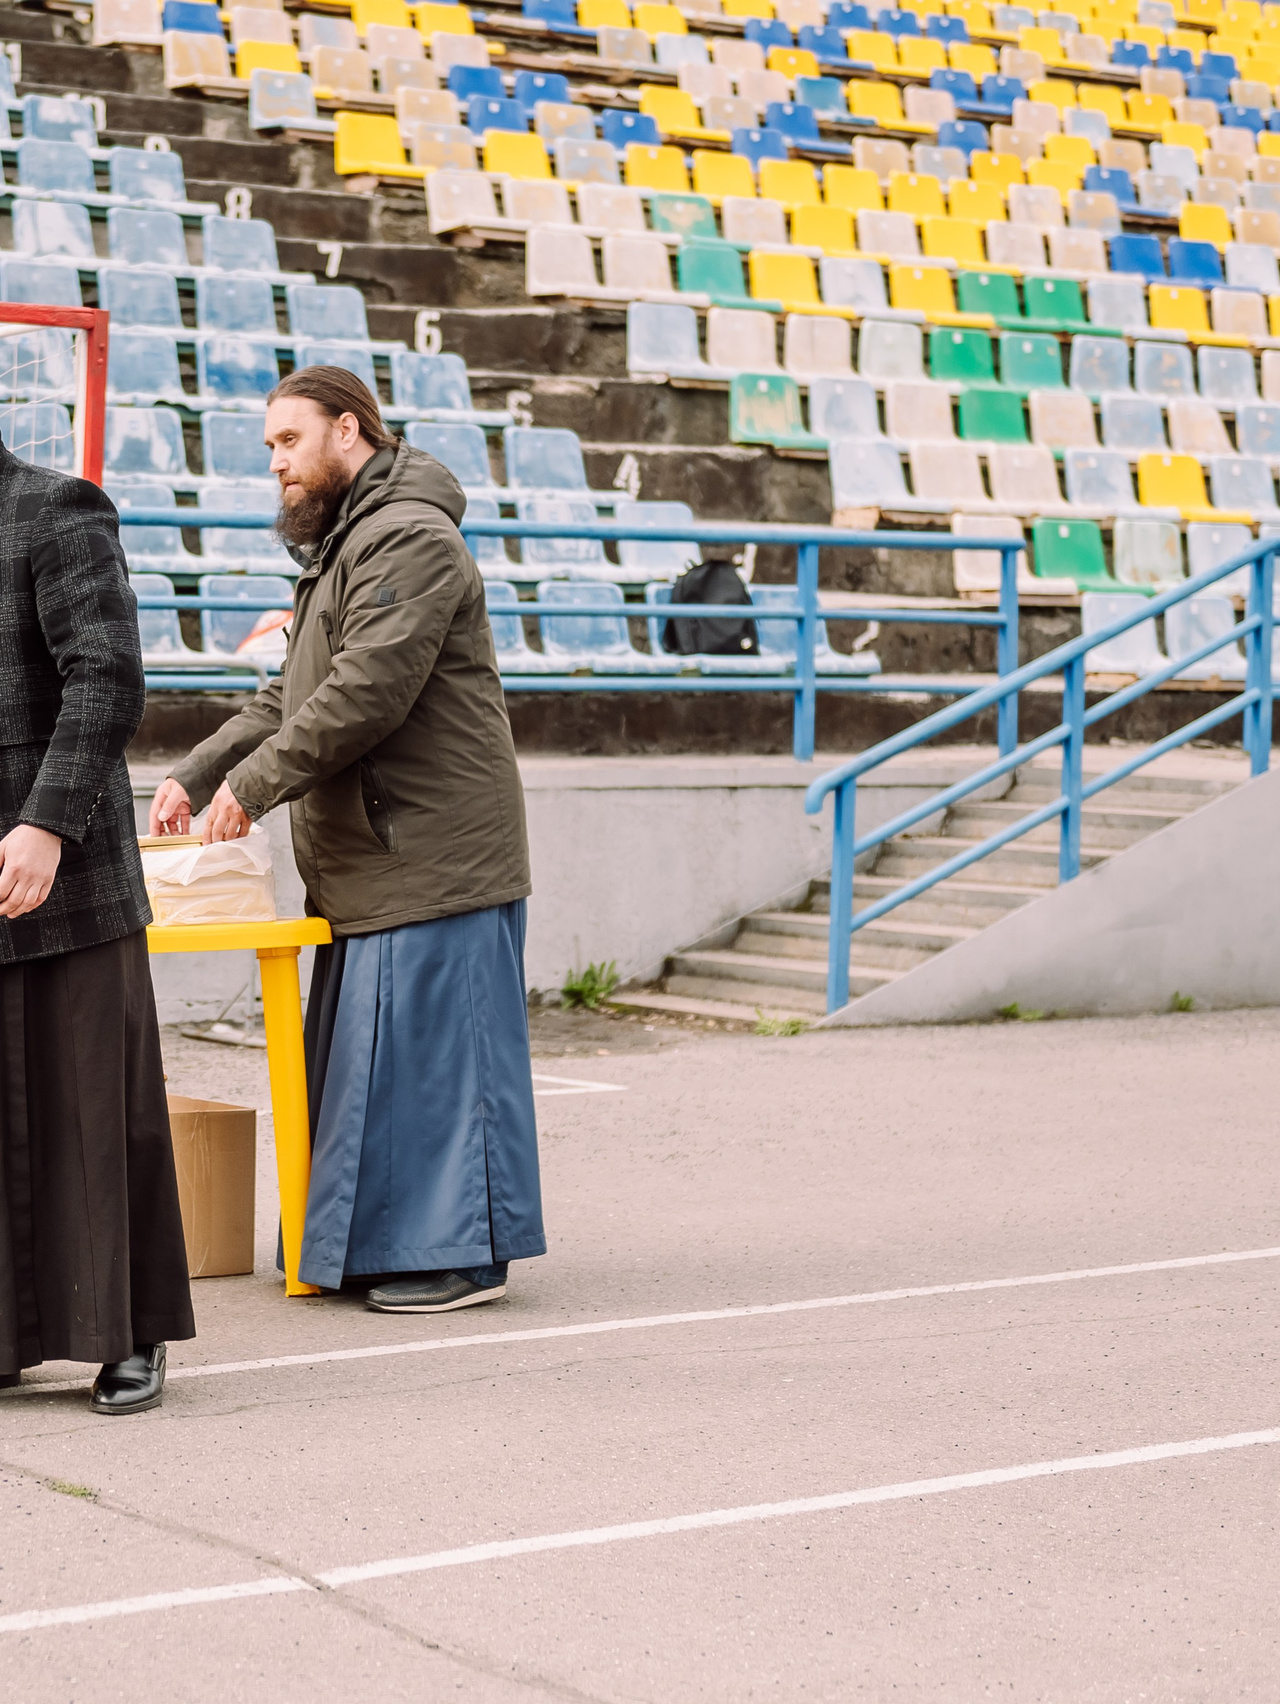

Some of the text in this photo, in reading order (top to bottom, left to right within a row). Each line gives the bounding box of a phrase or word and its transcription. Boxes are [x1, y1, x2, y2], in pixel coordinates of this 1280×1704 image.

[224, 187, 253, 219] 8
[316, 242, 343, 278] 7
[414, 310, 443, 354] 6
[612, 453, 641, 501] 4
